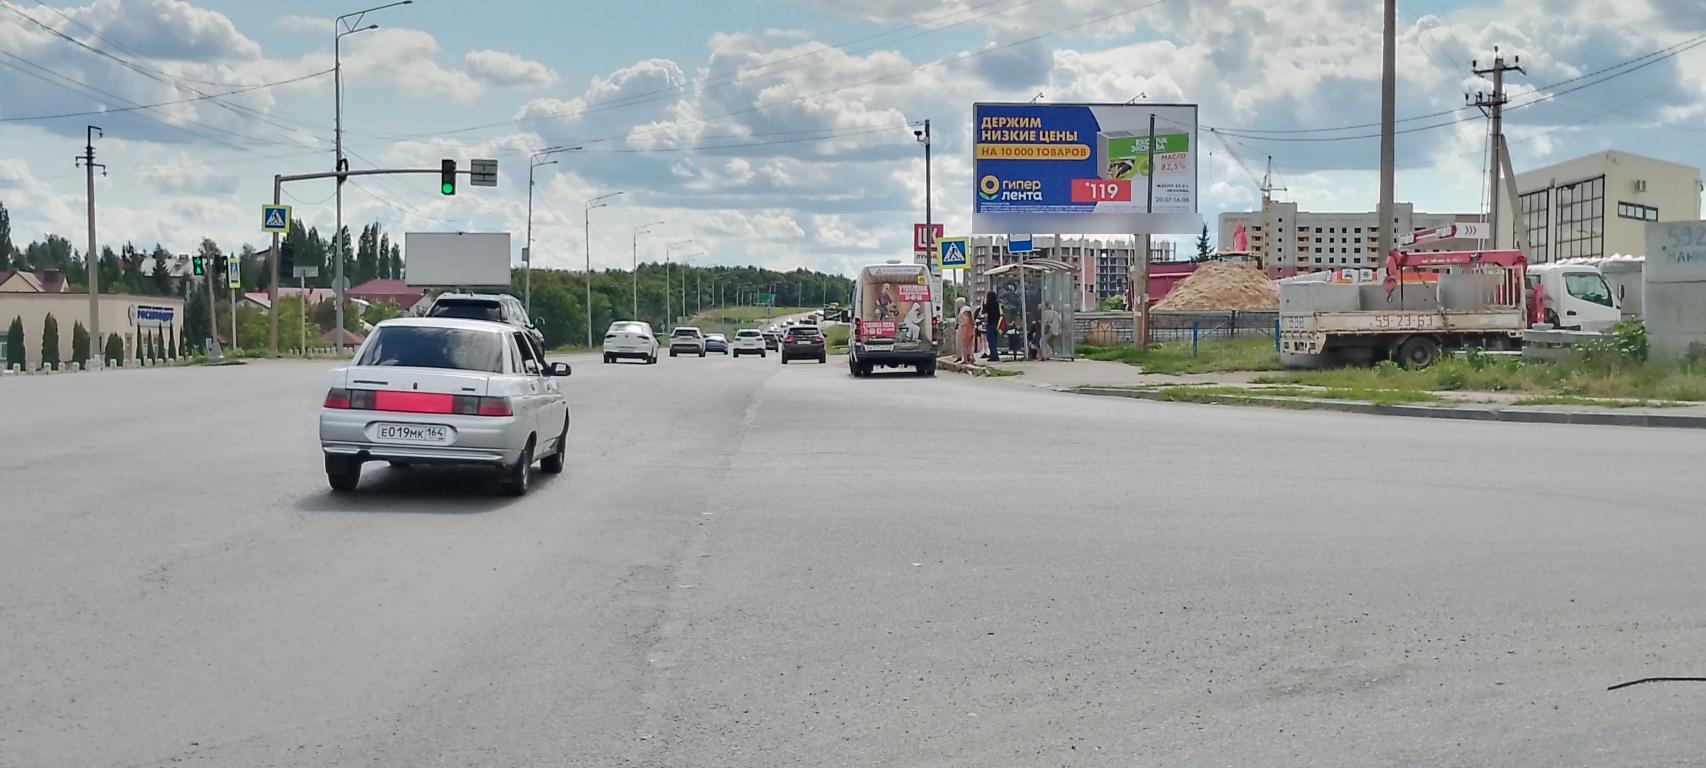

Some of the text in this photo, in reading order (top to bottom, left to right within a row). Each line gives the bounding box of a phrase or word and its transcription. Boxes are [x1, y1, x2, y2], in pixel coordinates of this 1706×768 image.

[981, 117, 1042, 129] ДЕРЖИМ
[981, 130, 1078, 143] НИЗКИЕ ЦЕНЫ
[981, 148, 998, 156] НА
[1037, 148, 1087, 157] ТОВАРОВ
[1002, 180, 1041, 191] гипер
[1001, 191, 1043, 201] лента
[381, 426, 444, 439] Е019МК 164
